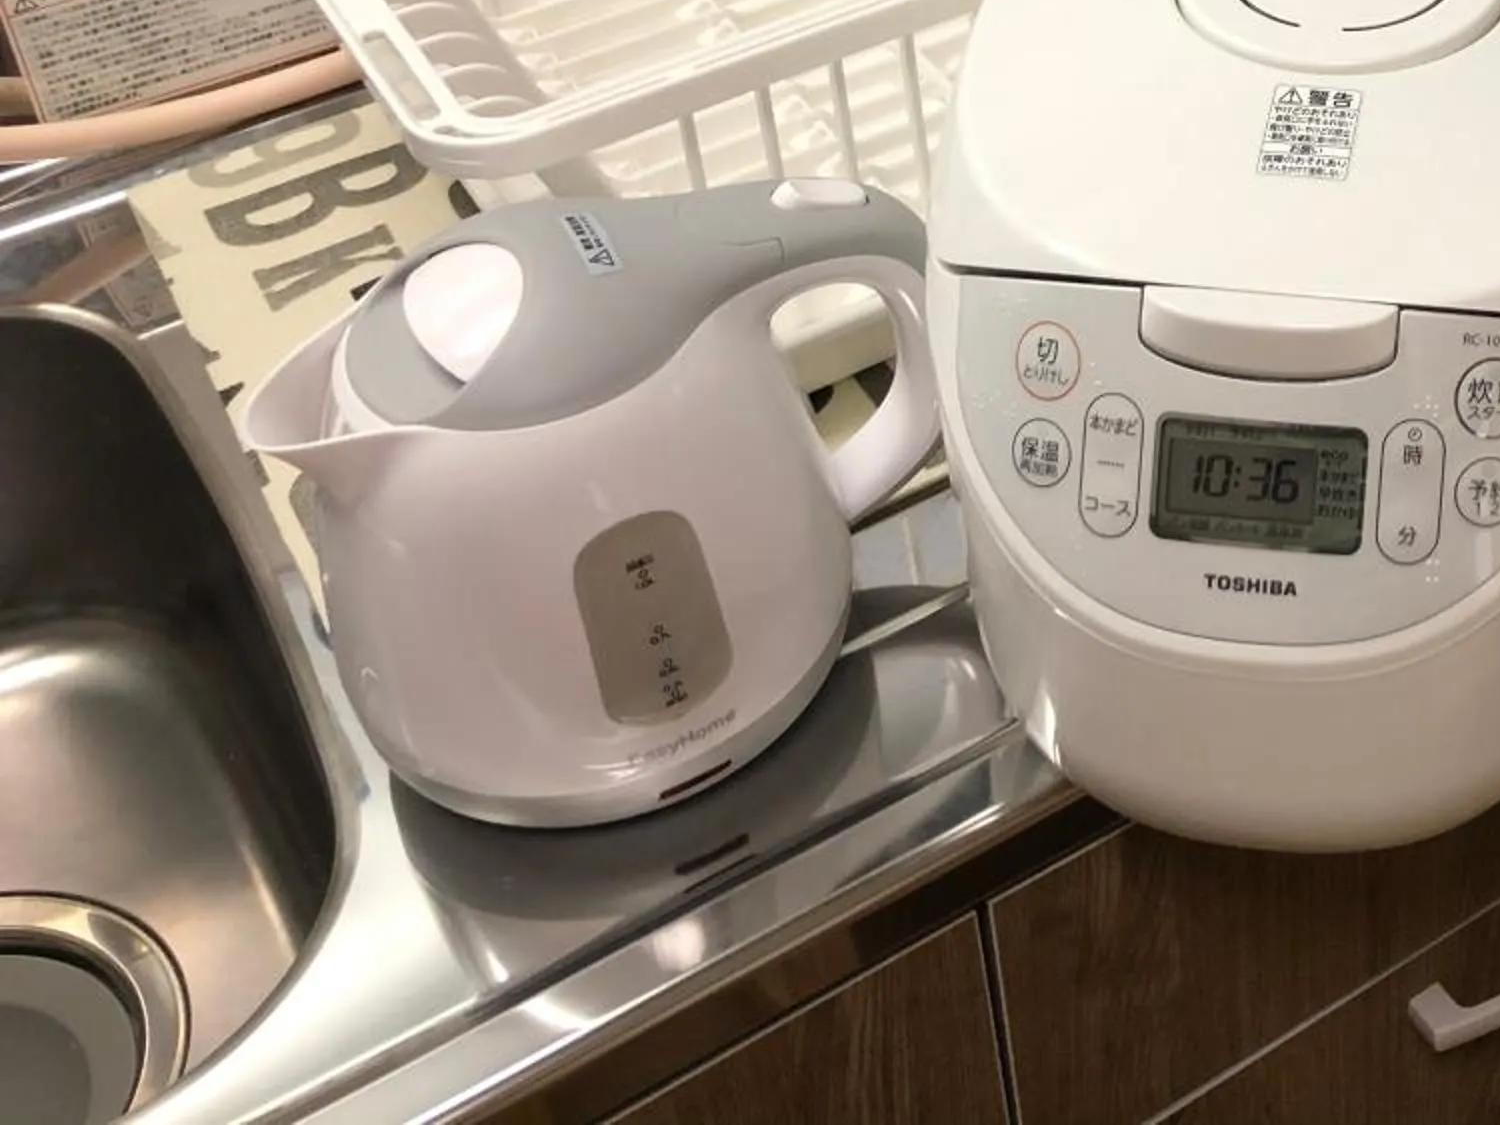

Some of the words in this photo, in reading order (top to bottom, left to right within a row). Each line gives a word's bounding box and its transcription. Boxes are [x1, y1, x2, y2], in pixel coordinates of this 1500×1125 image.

[1037, 336, 1059, 365] 切
[1021, 436, 1059, 462] 保温
[1403, 444, 1423, 466] 時
[1192, 454, 1299, 504] 10:36
[1085, 495, 1132, 517] コース
[1397, 526, 1417, 547] 分
[1204, 573, 1298, 597] TOSHIBA
